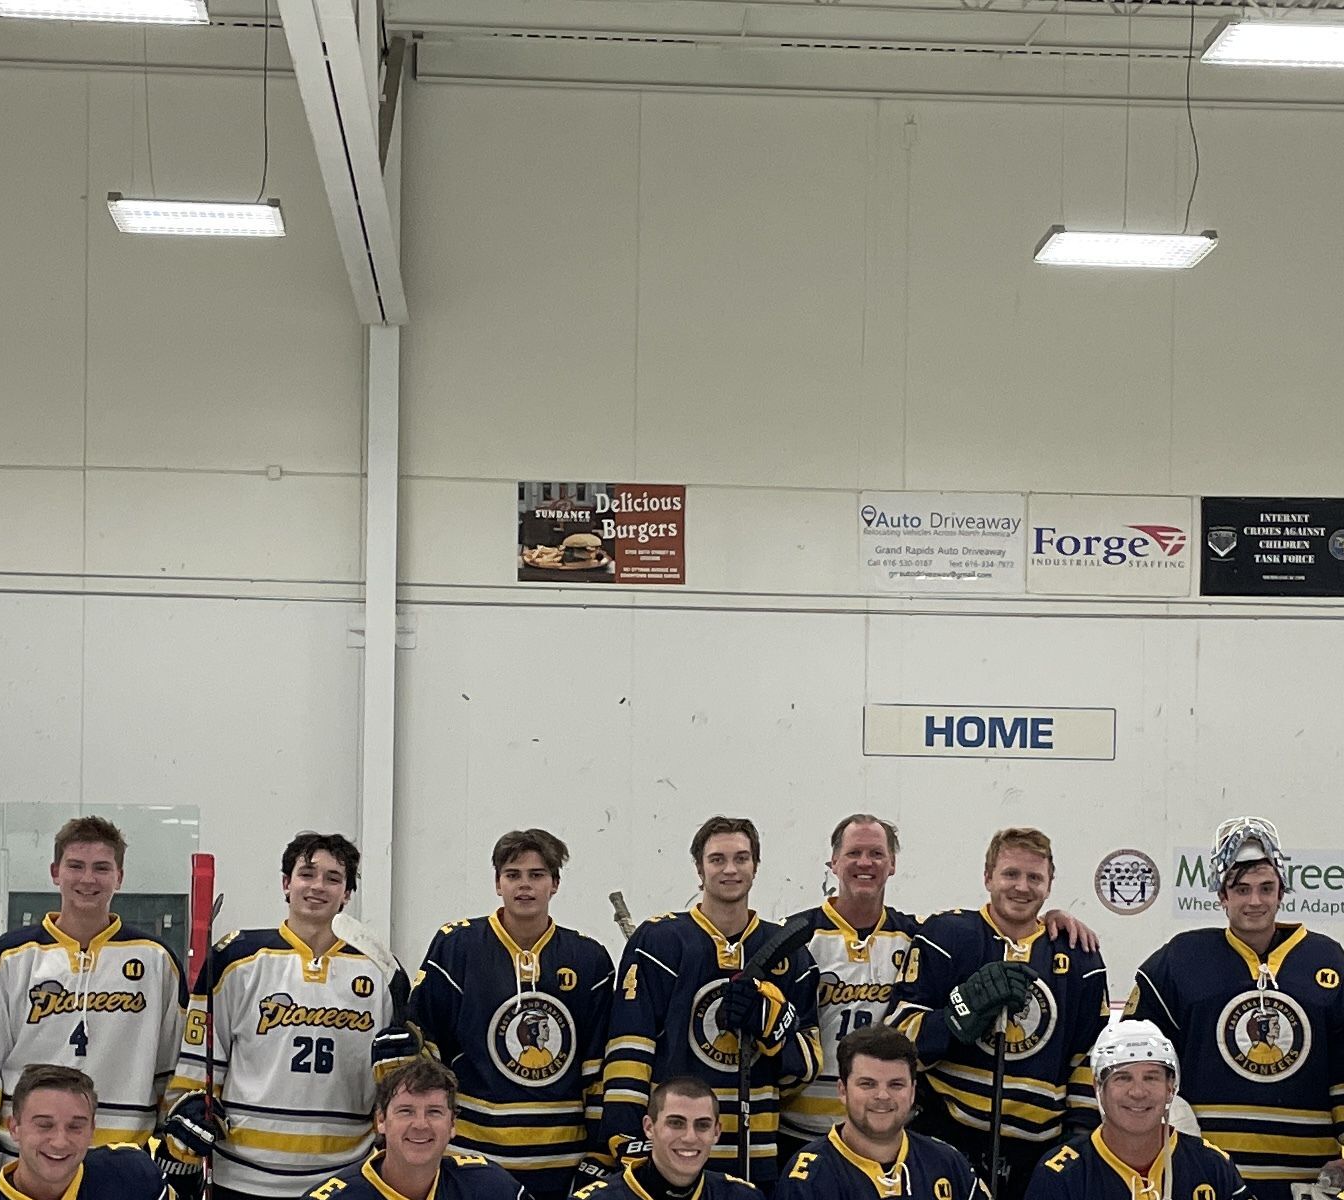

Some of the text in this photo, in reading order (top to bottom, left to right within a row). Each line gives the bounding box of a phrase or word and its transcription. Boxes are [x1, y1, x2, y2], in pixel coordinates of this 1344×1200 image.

[535, 509, 591, 520] SUNDANCE
[595, 491, 682, 514] Delicious
[601, 518, 678, 544] Burgers
[876, 511, 1022, 534] Auto Driveaway
[1259, 513, 1310, 523] INTERNET
[1243, 527, 1326, 537] CRIMES AGAINST
[1258, 540, 1310, 549] CHILDREN
[875, 545, 1007, 557] Grand Rapids Auto Driveaway
[1032, 527, 1150, 566] Forge
[1253, 554, 1315, 564] TASK FORCE
[1031, 558, 1185, 569] INDUSTRIAL STAFFING
[924, 715, 1054, 749] HOME
[354, 979, 372, 994] KJ
[622, 963, 639, 1000] 4
[27, 985, 147, 1024] Pioneers
[255, 996, 375, 1036] Pioneers
[68, 1021, 88, 1057] 4
[290, 1035, 336, 1075] 26
[506, 1050, 568, 1080] PIONEERS
[1235, 1049, 1299, 1075] PIONEERS
[788, 1152, 818, 1181] E
[1044, 1144, 1080, 1172] E
